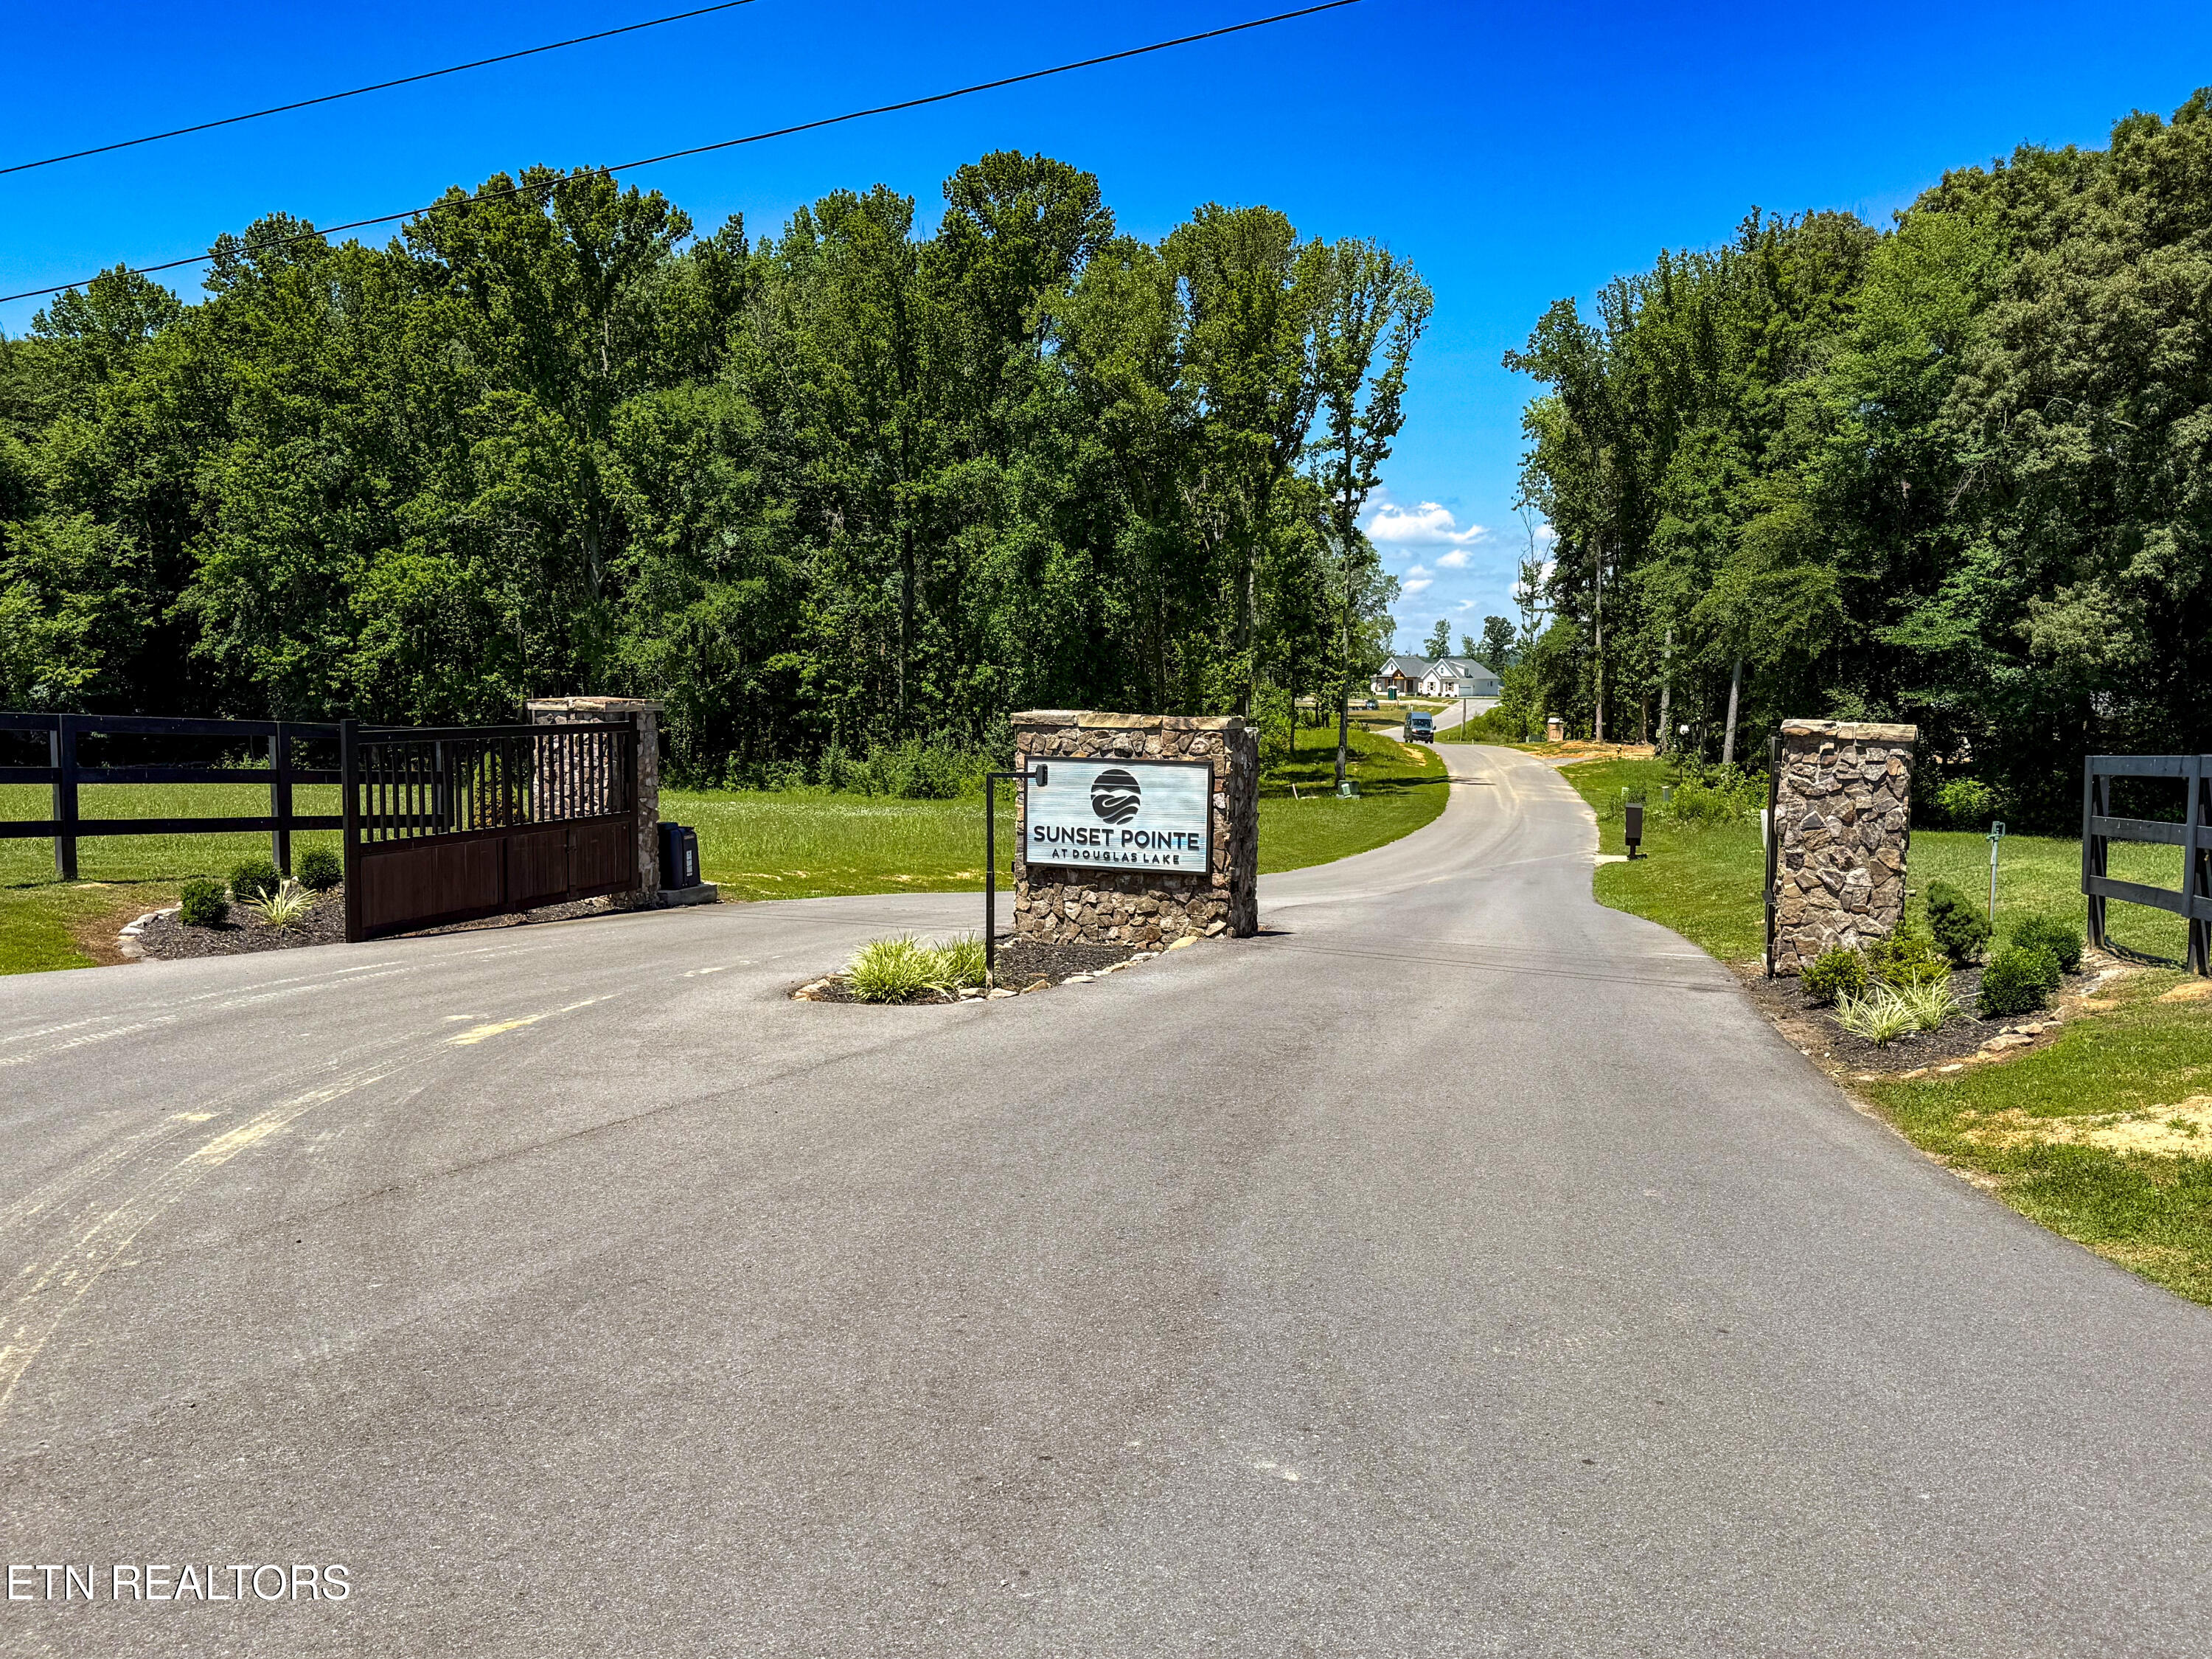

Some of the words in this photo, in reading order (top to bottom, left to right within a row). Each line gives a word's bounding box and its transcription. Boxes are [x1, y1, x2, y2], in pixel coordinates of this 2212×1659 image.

[1034, 825, 1114, 846] SUNSET
[1121, 830, 1200, 851] POINTE
[1051, 848, 1068, 859] AT
[1072, 849, 1138, 863] DOUGLAS
[1143, 854, 1180, 865] LAKE
